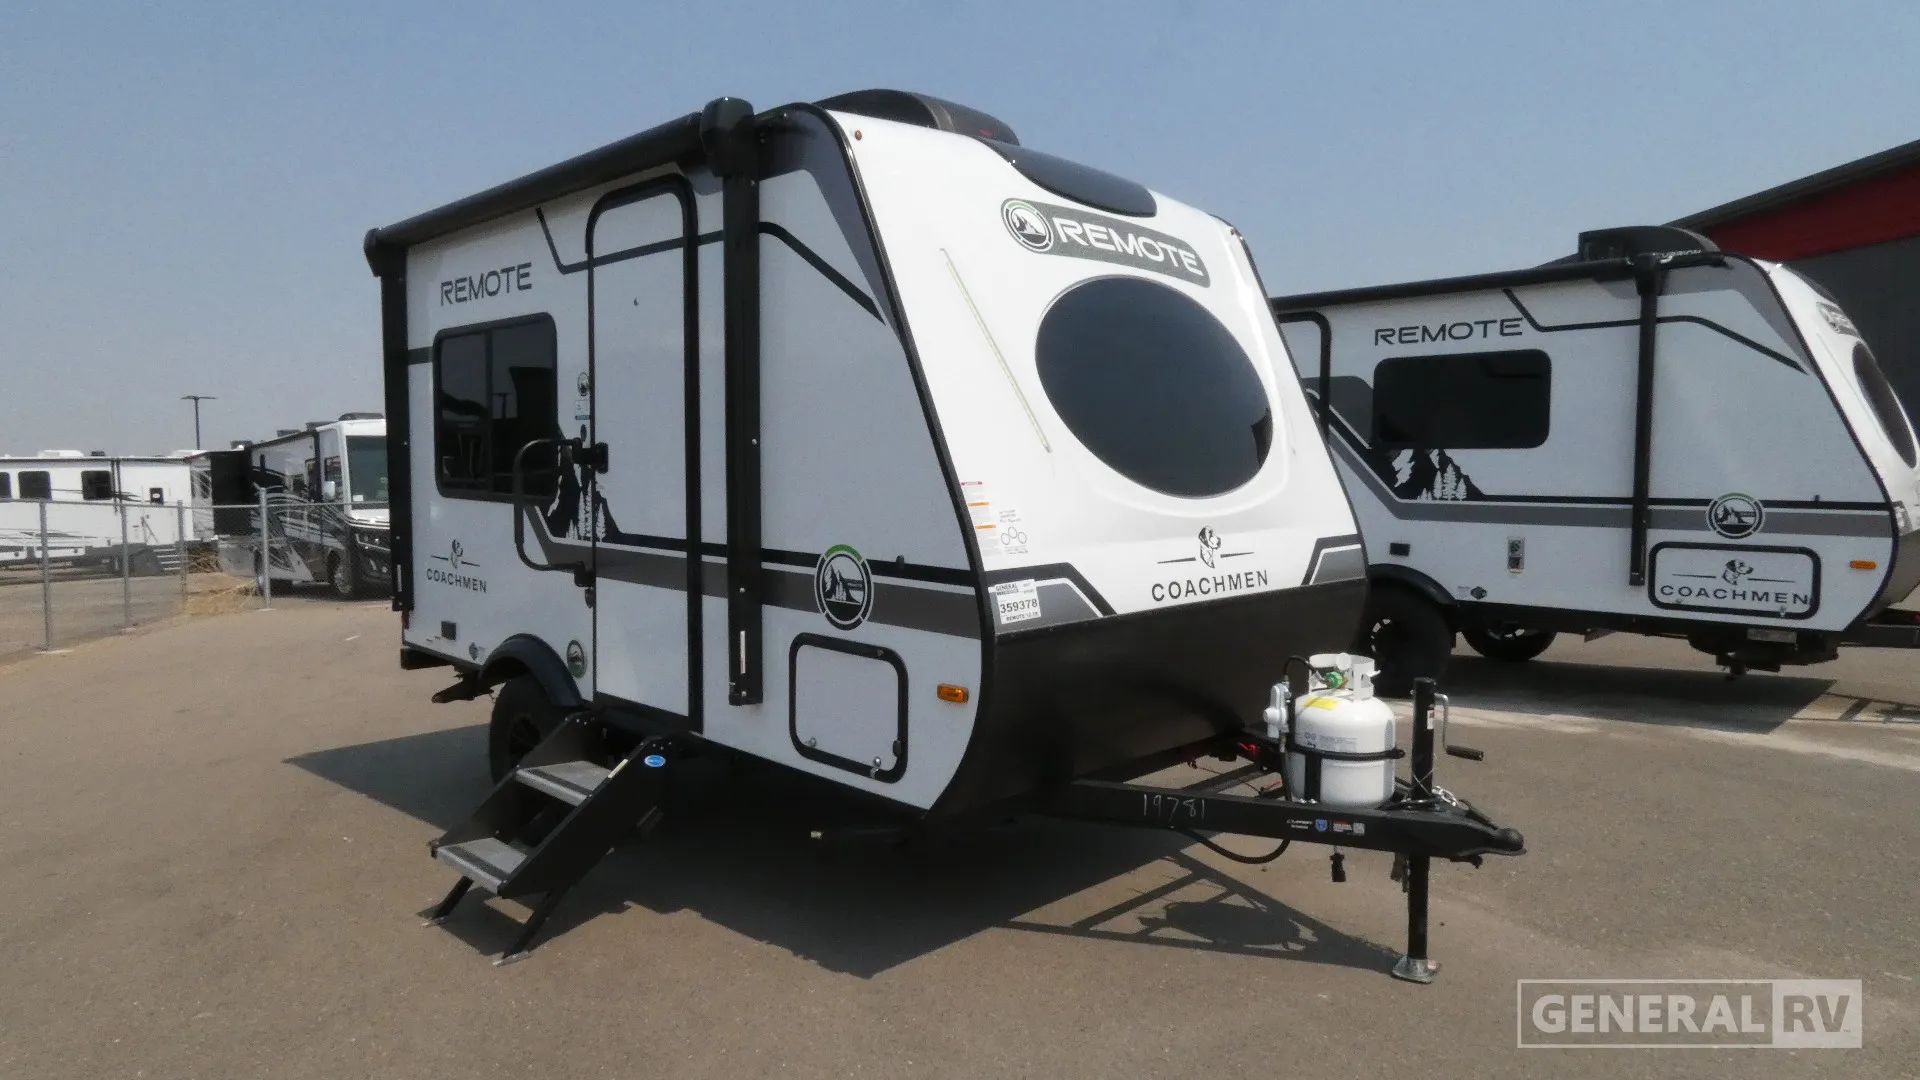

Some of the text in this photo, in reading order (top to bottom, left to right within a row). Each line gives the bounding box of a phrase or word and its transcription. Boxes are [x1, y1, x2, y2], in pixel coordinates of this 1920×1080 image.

[1052, 217, 1204, 276] REMOTE
[440, 263, 533, 306] REMOTE
[1374, 317, 1523, 346] REMOTE
[427, 568, 487, 594] COACHMEN
[1151, 569, 1269, 602] COACHMEN
[1660, 584, 1809, 606] COACHMEN
[999, 598, 1038, 614] 359378
[1143, 793, 1205, 822] 19781
